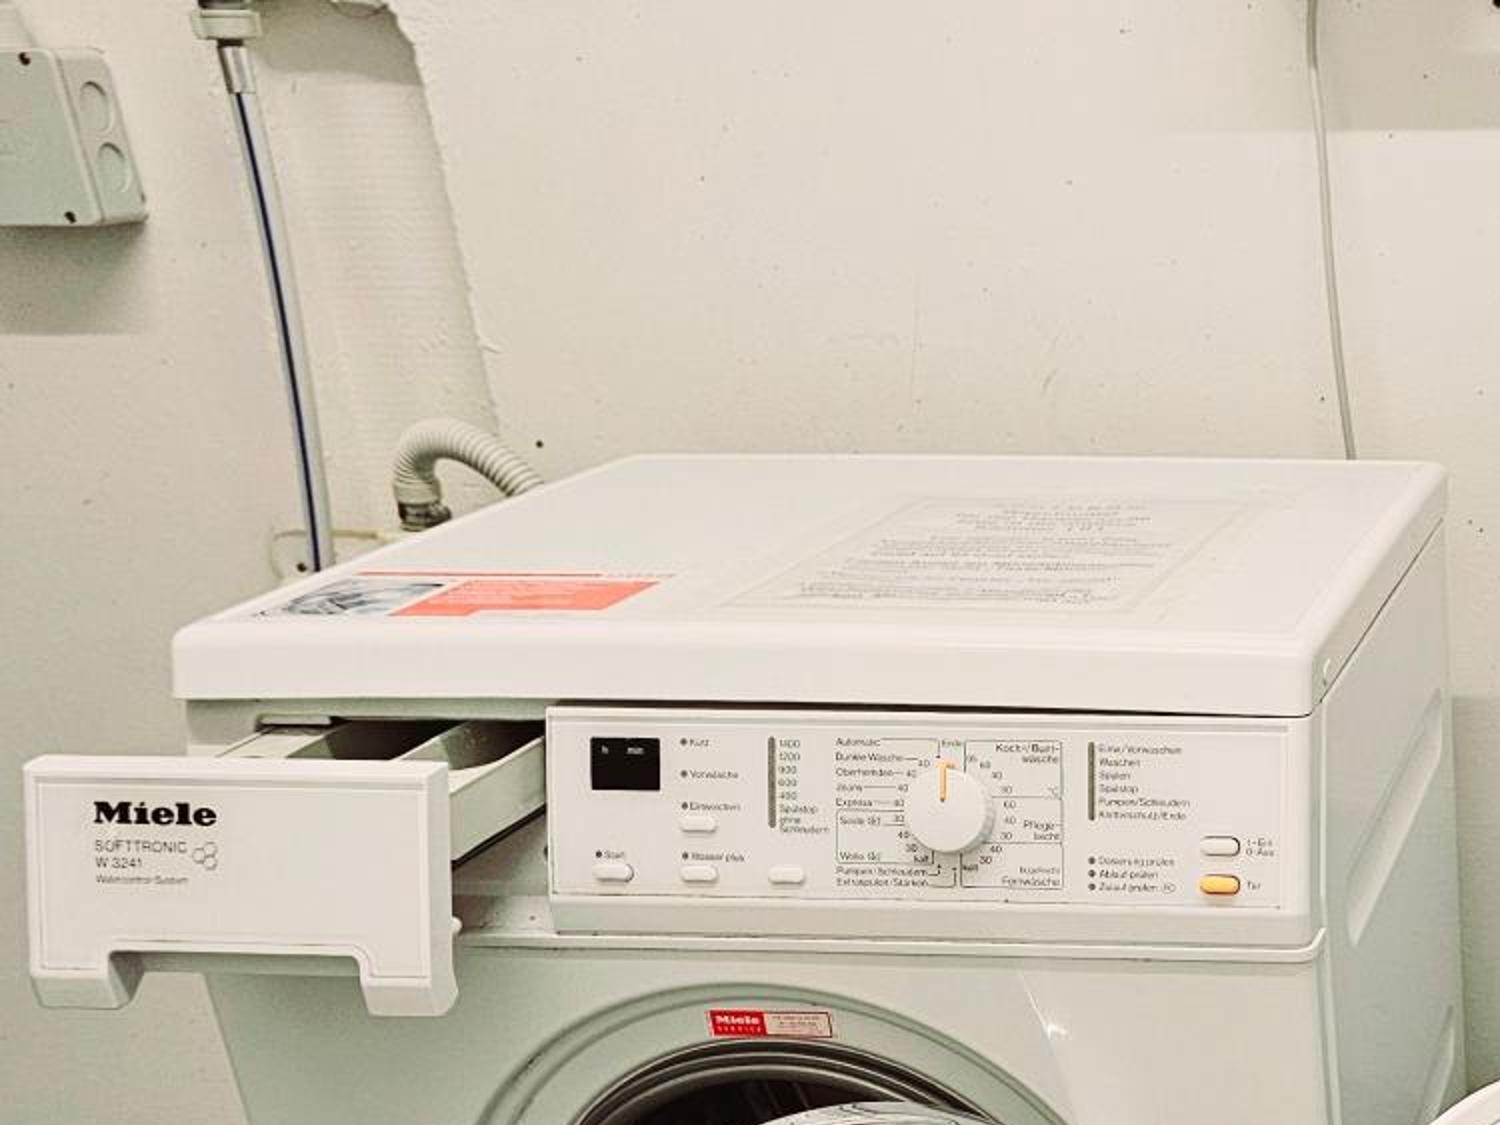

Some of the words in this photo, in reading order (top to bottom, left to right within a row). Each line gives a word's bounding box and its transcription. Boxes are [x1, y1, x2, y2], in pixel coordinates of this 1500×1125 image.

[93, 801, 218, 827] Miele
[95, 840, 188, 854] SOFTTRONIC
[95, 857, 108, 868] W
[112, 857, 143, 869] 3241
